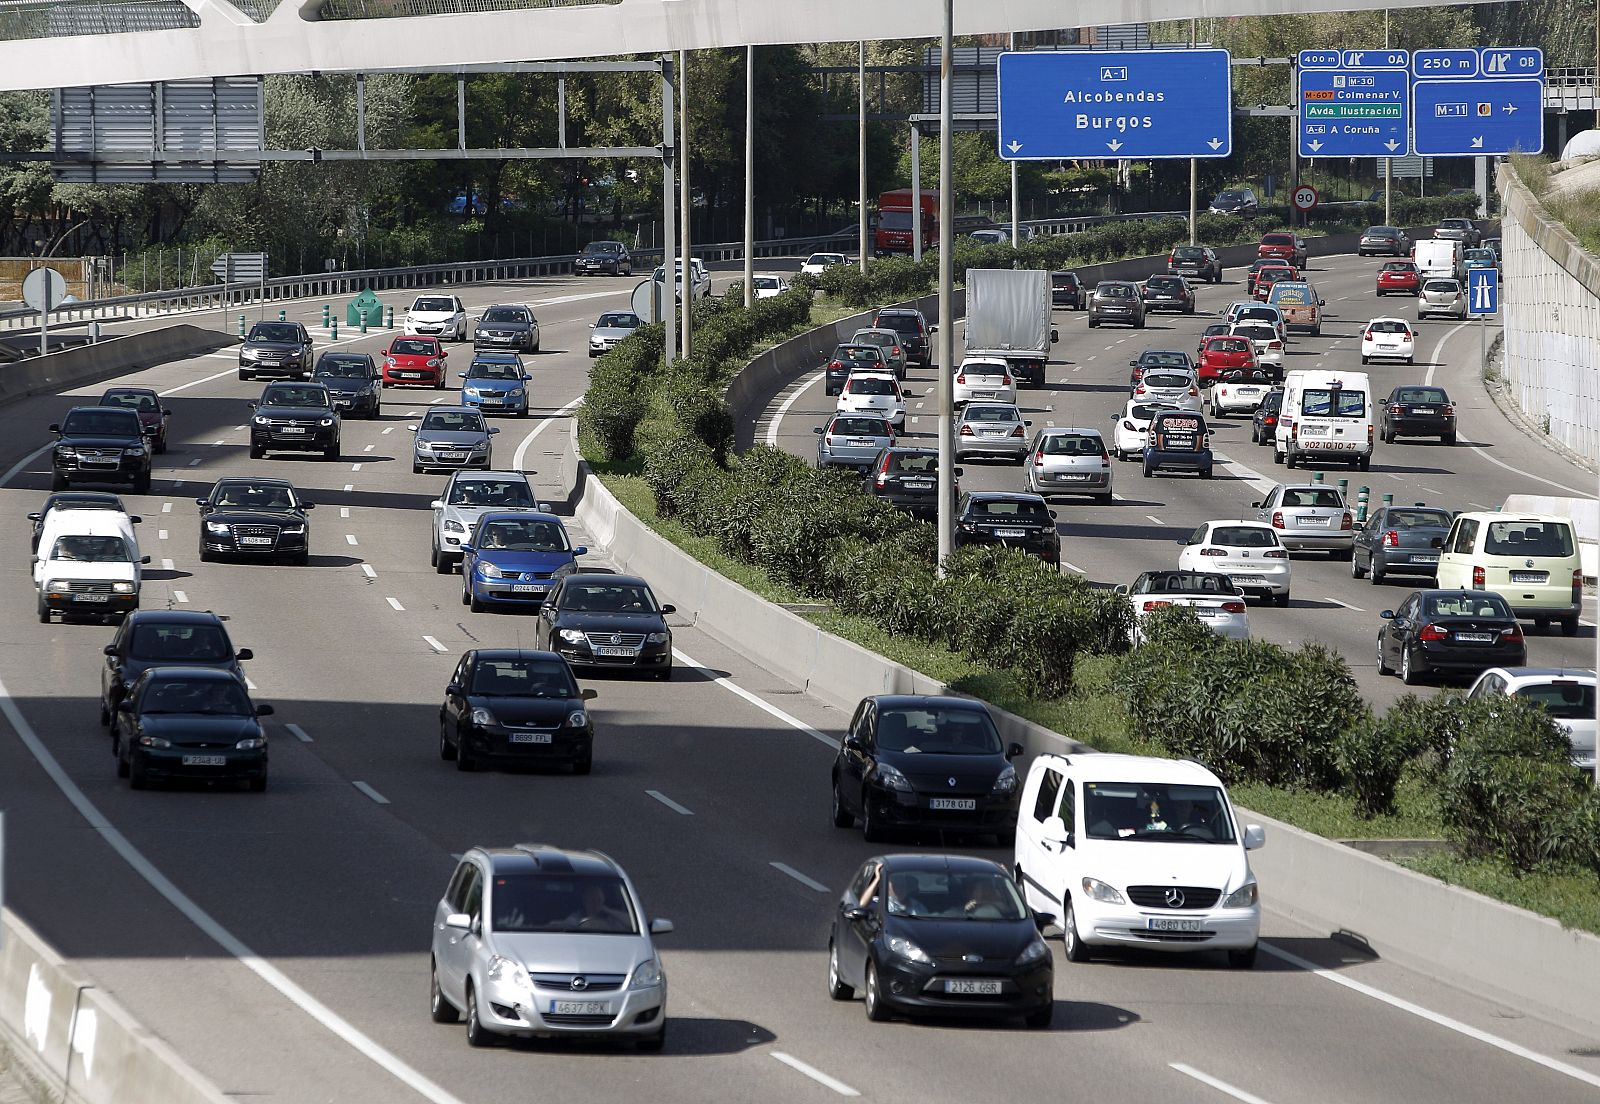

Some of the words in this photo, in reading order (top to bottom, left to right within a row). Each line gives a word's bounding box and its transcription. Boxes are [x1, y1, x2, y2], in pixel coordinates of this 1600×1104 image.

[1304, 55, 1325, 63] 400
[1423, 58, 1451, 69] 250
[1459, 59, 1470, 68] m
[1103, 68, 1126, 79] A-1
[1350, 78, 1373, 86] M-30
[1064, 90, 1165, 104] Alcobendas
[1305, 91, 1334, 99] M-607
[1337, 90, 1390, 99] Colmenar
[1309, 107, 1336, 116] Avda.
[1340, 106, 1399, 116] Ilustración
[1437, 105, 1466, 115] M-11
[1076, 114, 1153, 133] Burgos
[1331, 126, 1338, 134] A
[1343, 125, 1380, 134] Coruña
[1297, 193, 1313, 203] 90
[1304, 441, 1321, 449] 902
[1334, 442, 1344, 450] 10
[1346, 442, 1357, 450] 47
[935, 800, 956, 808] 3178
[958, 800, 974, 809] GTJ
[951, 983, 975, 993] 2126
[558, 1003, 584, 1014] 4637
